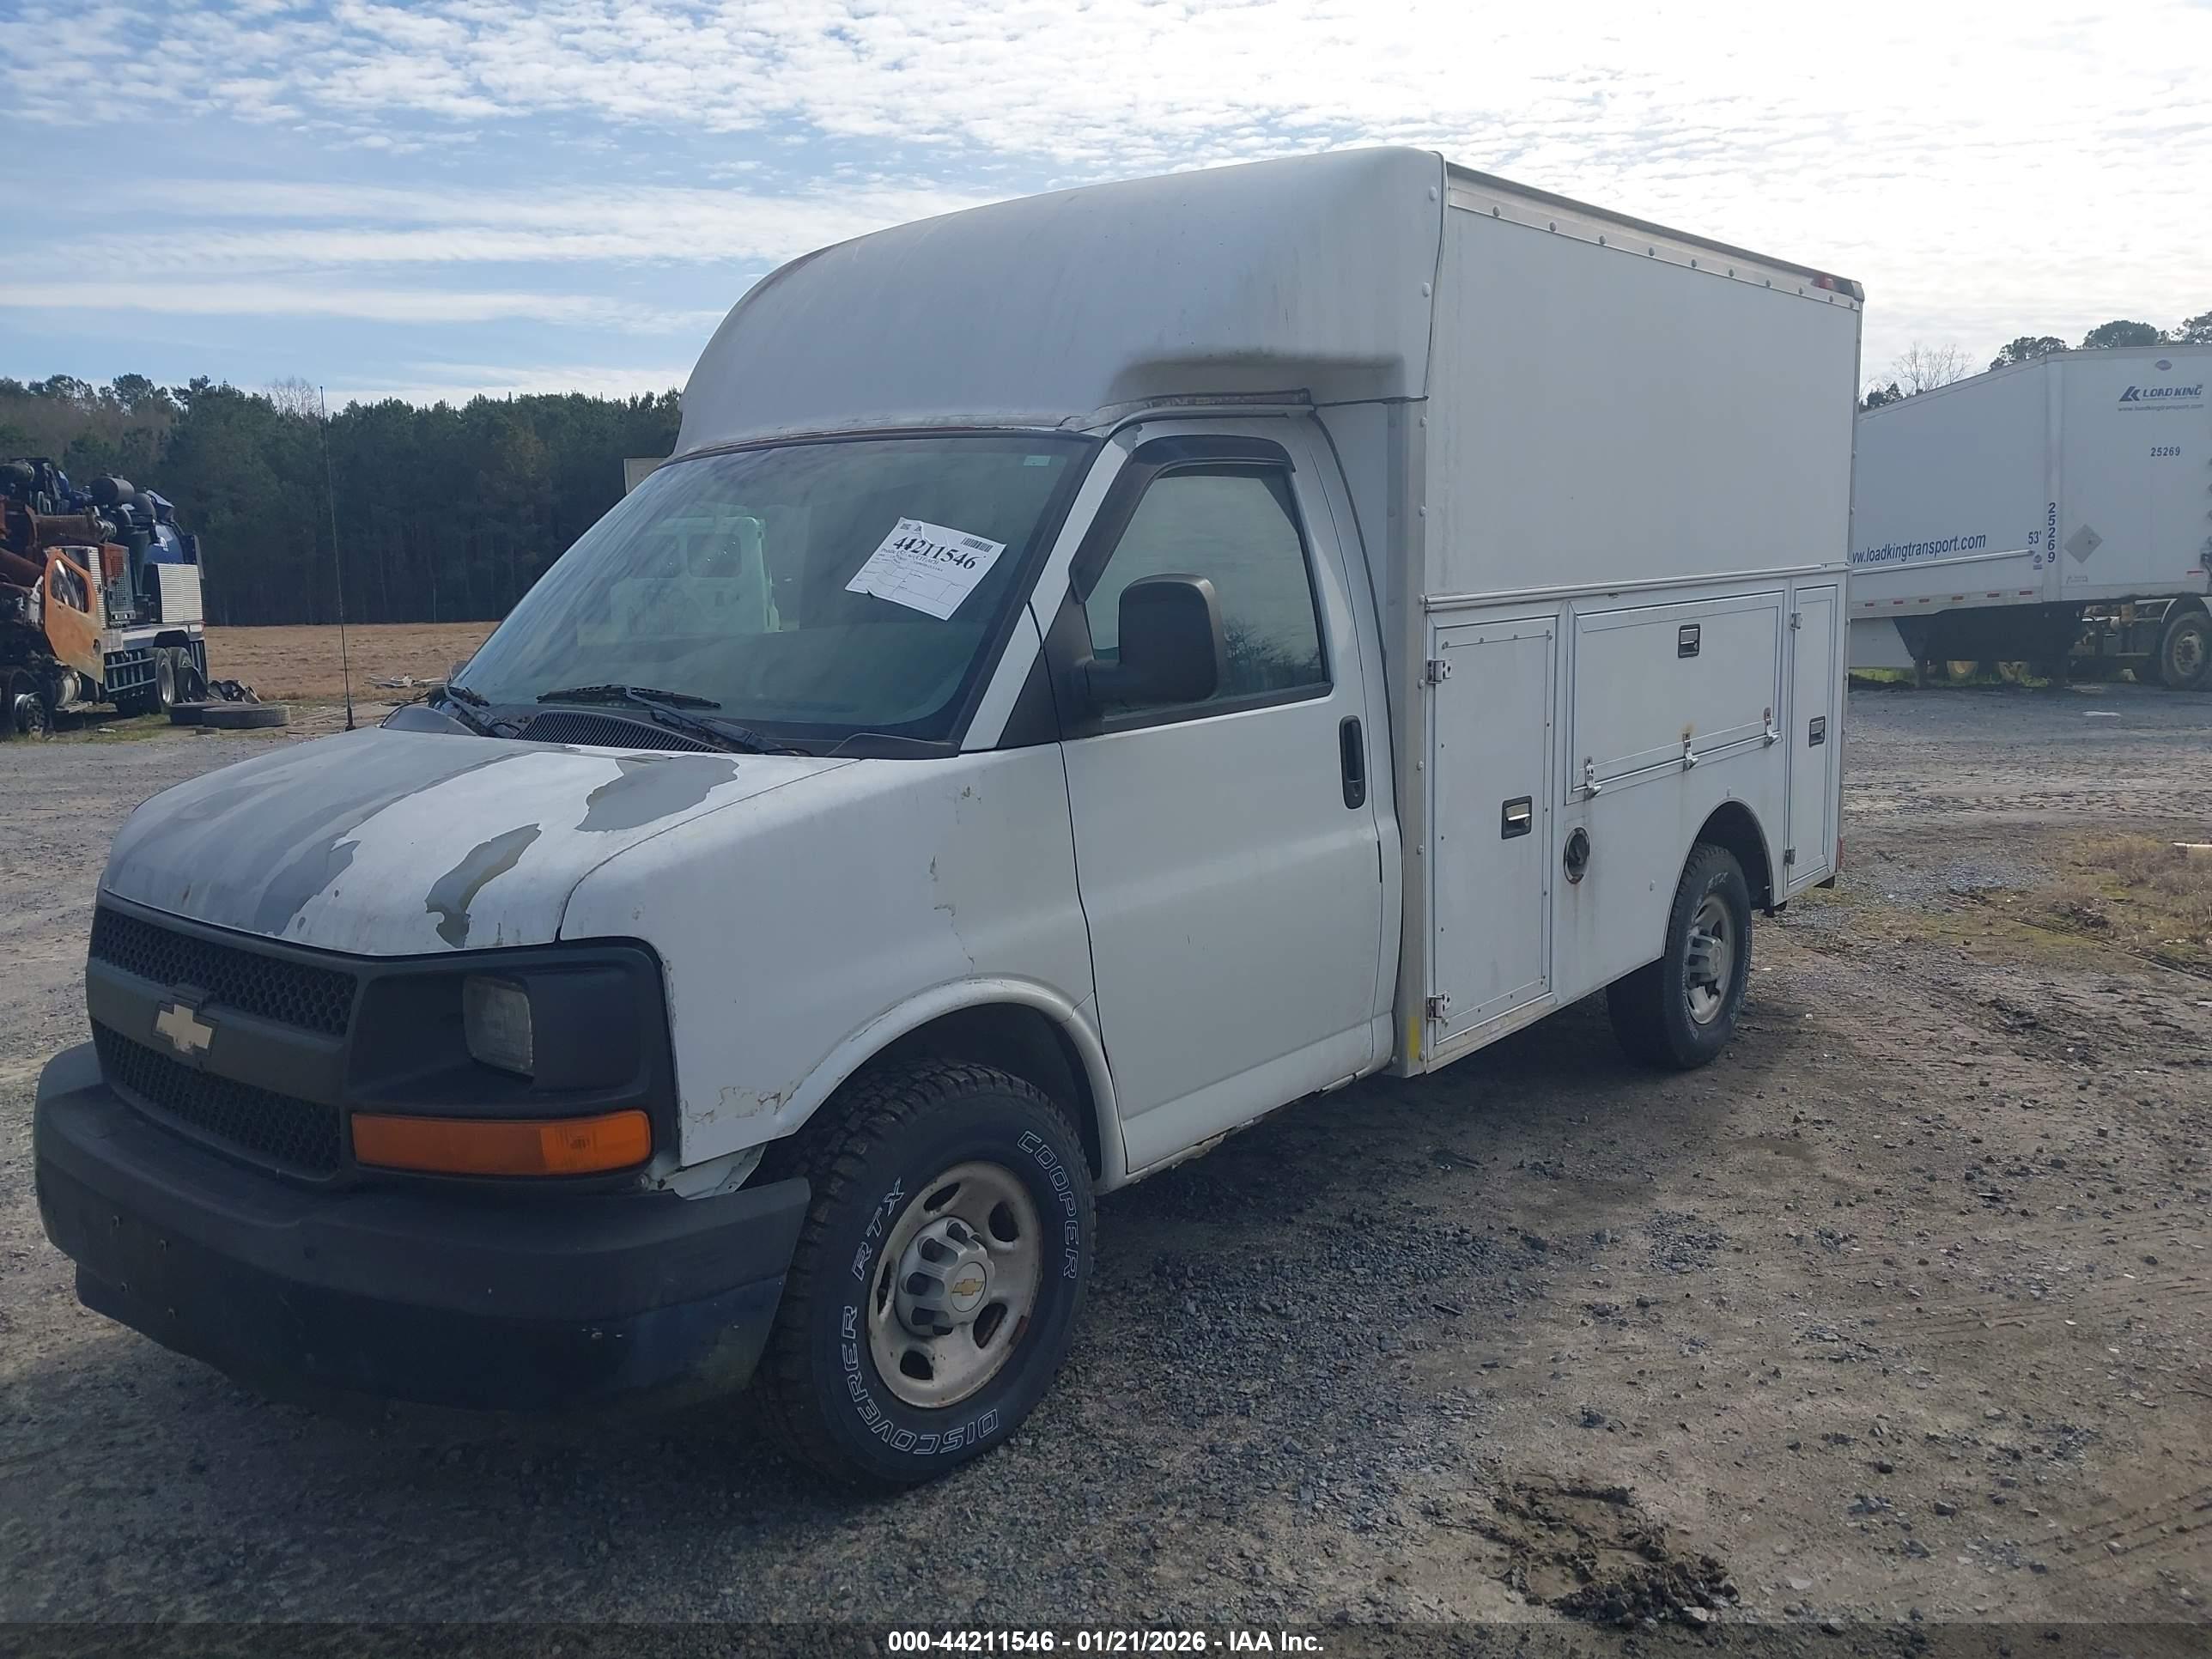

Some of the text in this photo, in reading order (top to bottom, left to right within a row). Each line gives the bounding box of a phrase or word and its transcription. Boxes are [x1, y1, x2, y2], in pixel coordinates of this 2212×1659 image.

[2143, 385, 2203, 398] LOAD KING
[2150, 446, 2181, 457] 25269
[2028, 531, 2042, 545] 53'
[2047, 501, 2056, 563] 25269
[893, 536, 979, 570] 44211546
[1017, 1131, 1079, 1279] COOPER
[839, 1176, 999, 1455] DISCOVERER RTX
